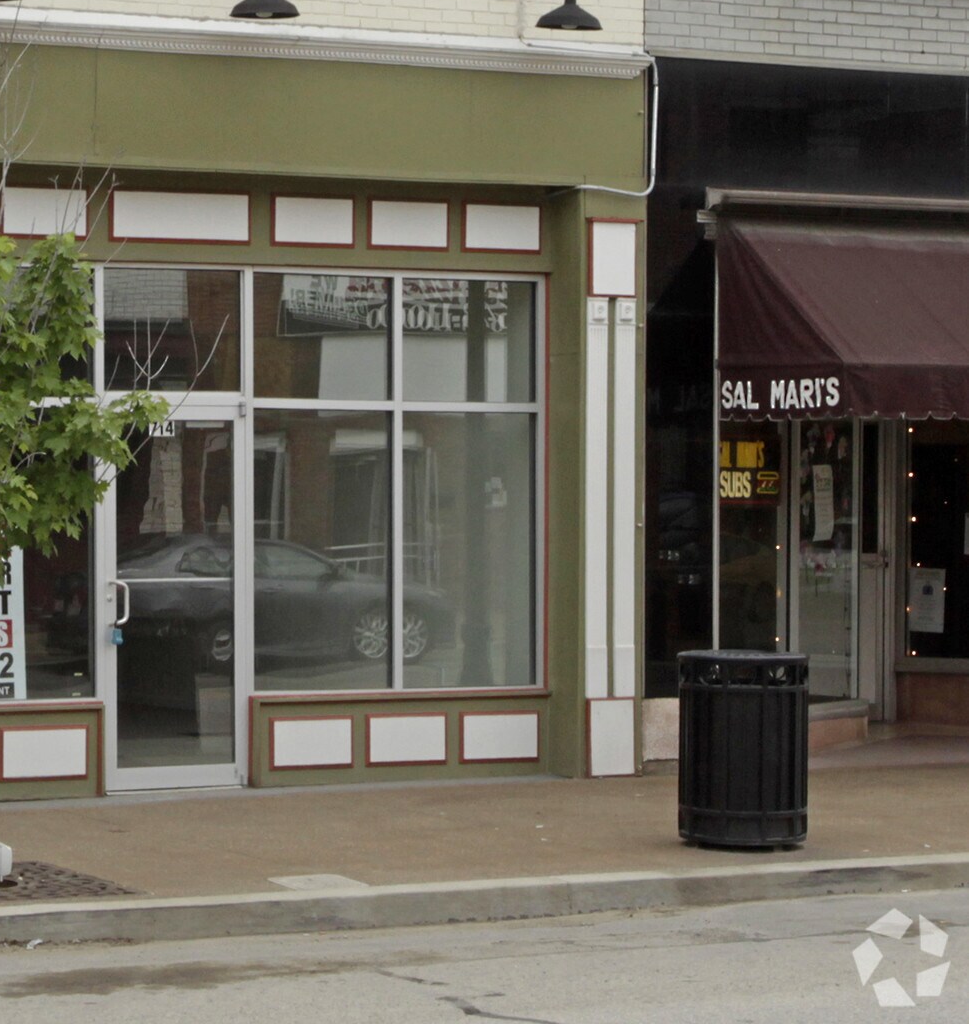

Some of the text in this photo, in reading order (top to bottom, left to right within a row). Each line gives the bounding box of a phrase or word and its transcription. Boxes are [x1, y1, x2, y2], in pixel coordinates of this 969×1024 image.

[721, 377, 840, 410] SAL MARI'S
[719, 471, 751, 498] SUBS
